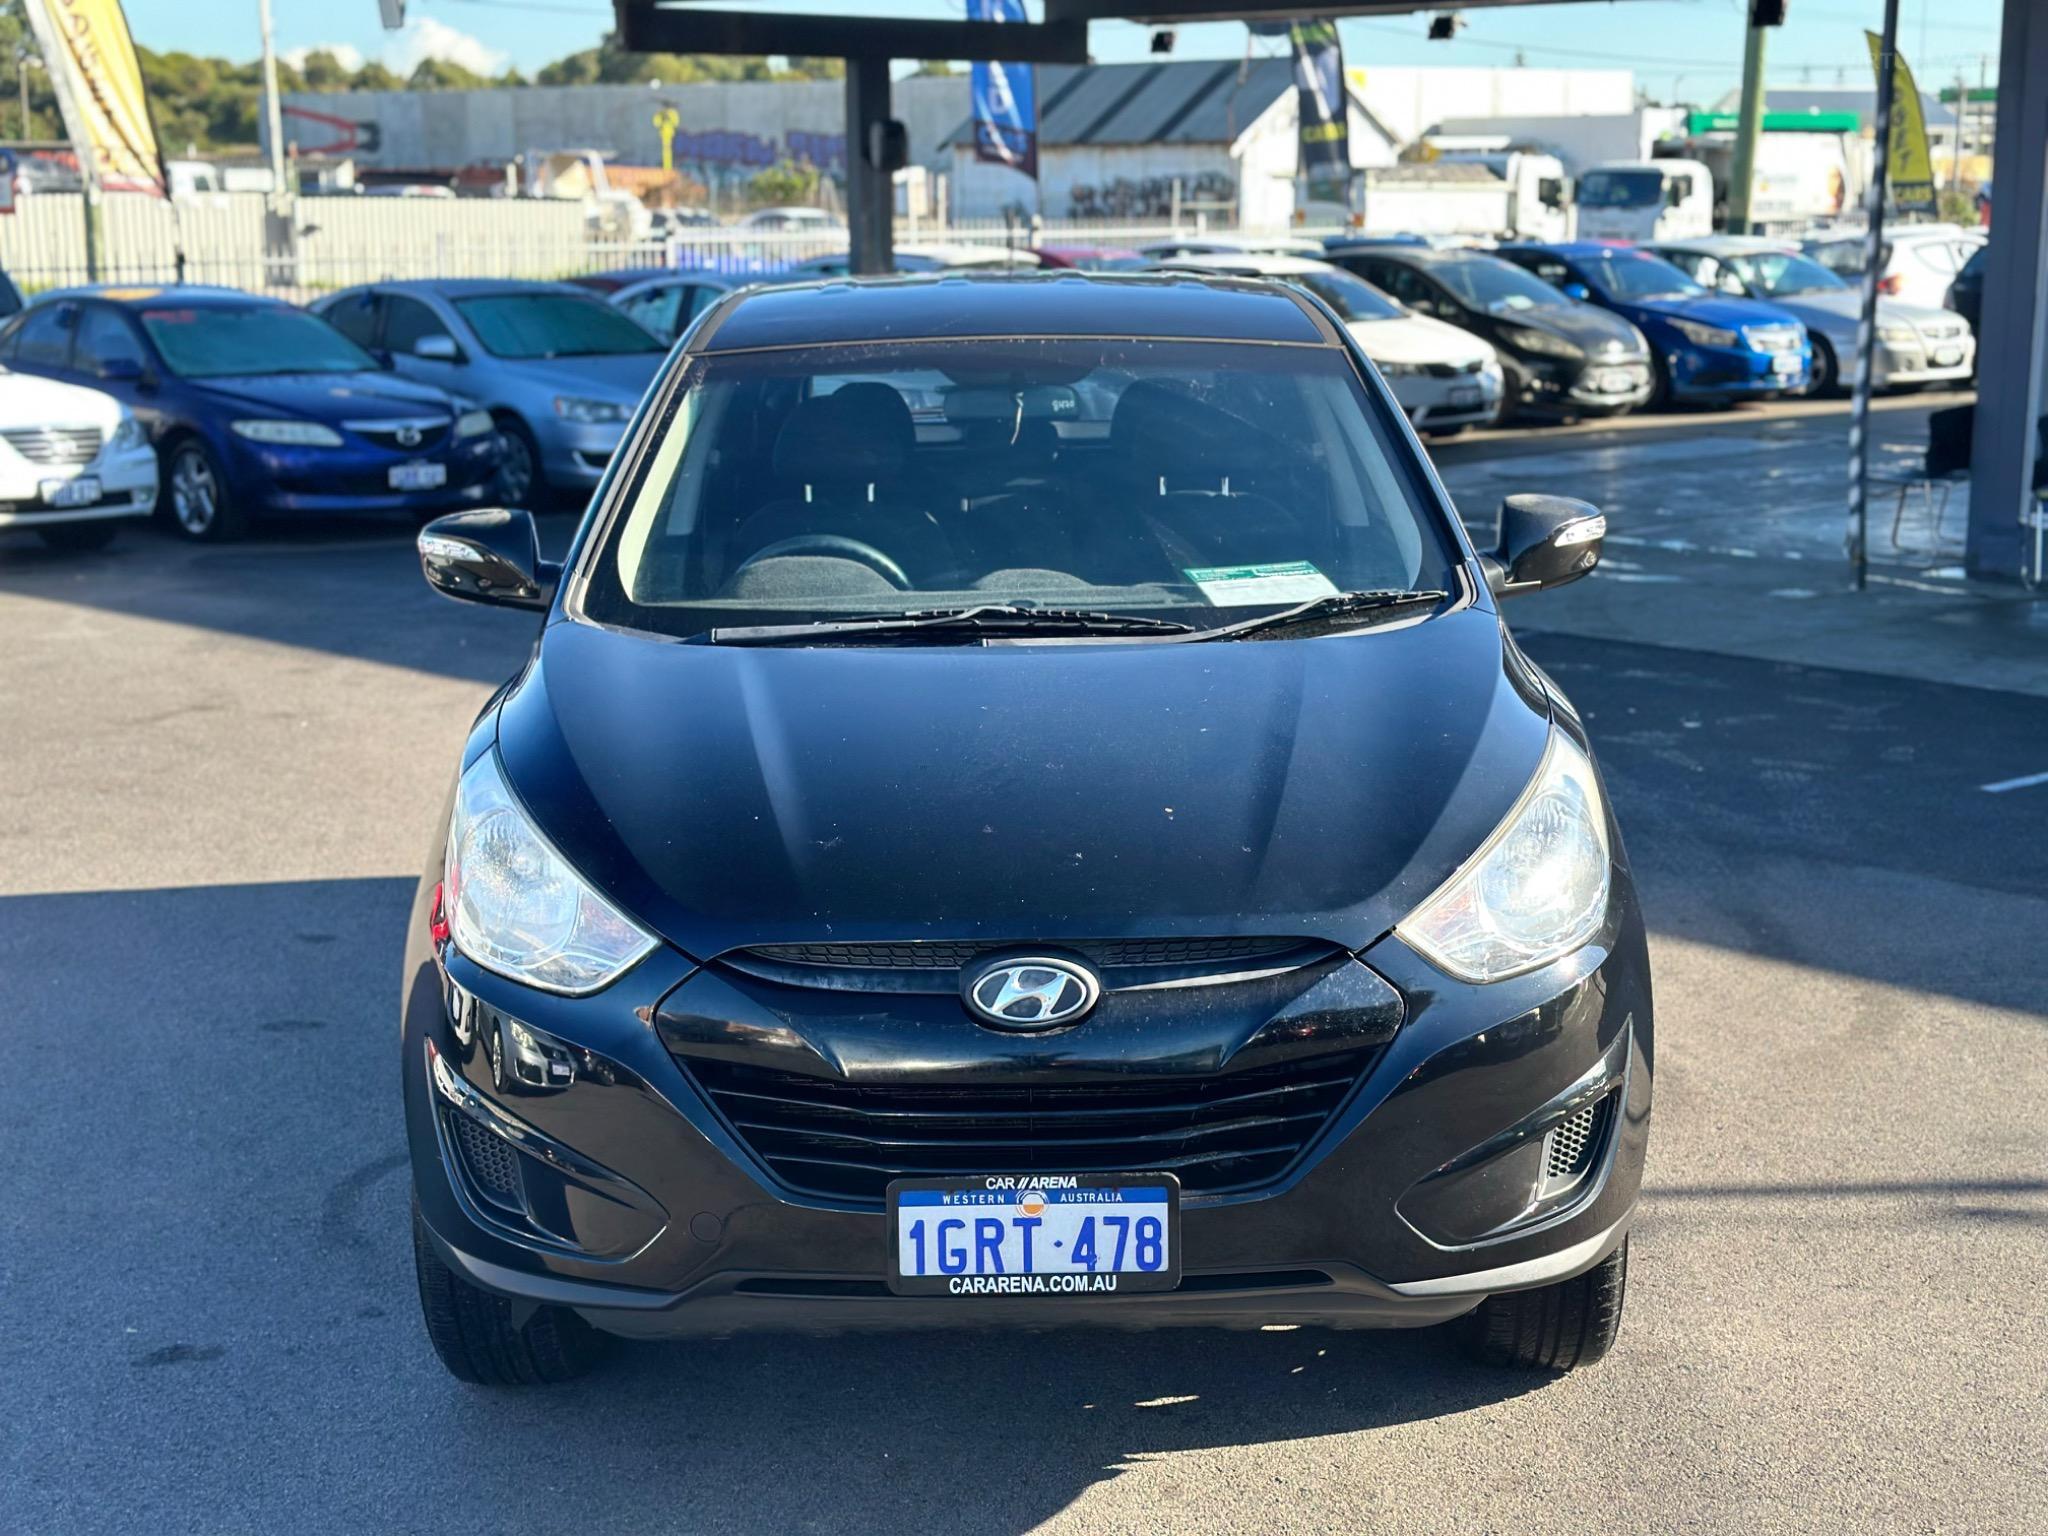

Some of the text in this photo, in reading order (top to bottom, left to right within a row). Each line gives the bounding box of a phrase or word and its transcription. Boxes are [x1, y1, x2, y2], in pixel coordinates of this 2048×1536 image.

[985, 1177, 1015, 1190] CAR
[943, 1192, 1123, 1205] WESTERN AUSTRALIA
[949, 1275, 1117, 1294] CARARENA.COM.AU
